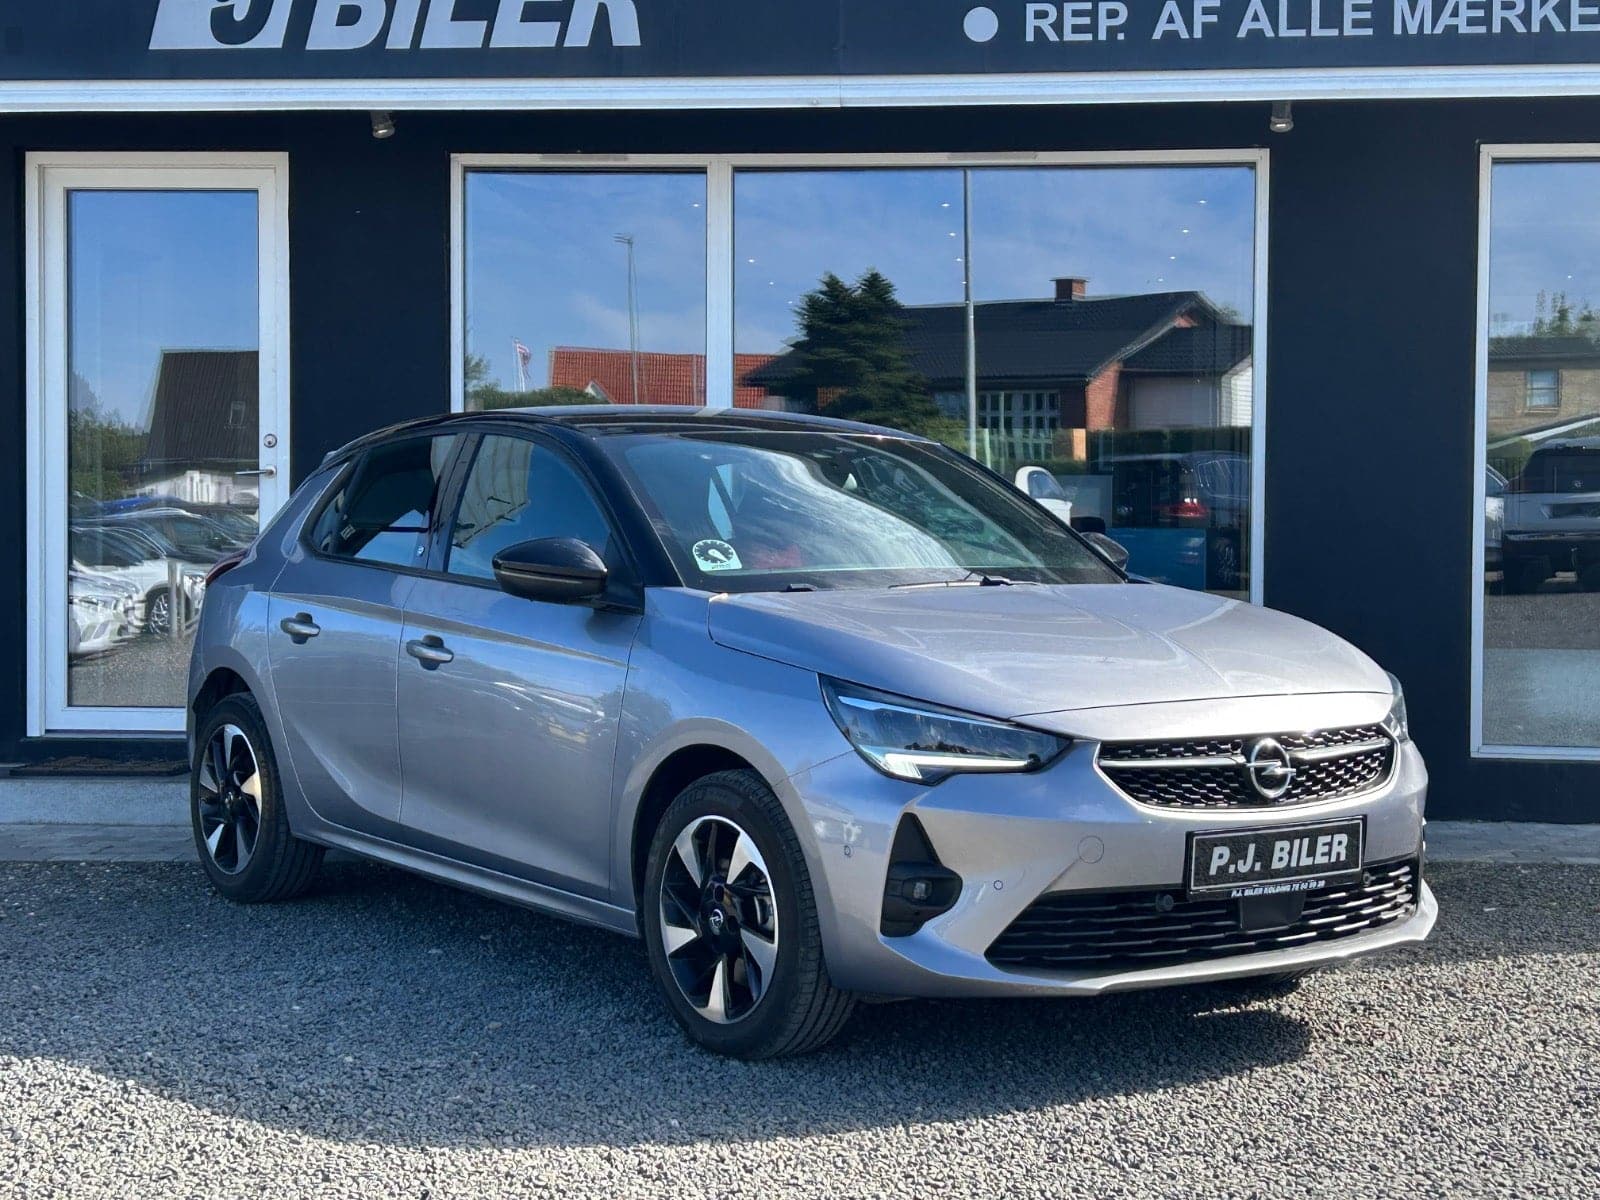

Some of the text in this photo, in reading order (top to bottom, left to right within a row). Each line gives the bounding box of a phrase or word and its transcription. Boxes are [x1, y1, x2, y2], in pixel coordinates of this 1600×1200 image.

[1025, 1, 1129, 42] REP.
[1152, 0, 1221, 40] AF
[1236, 0, 1374, 37] ALLE
[1209, 833, 1348, 876] P.J. BILER
